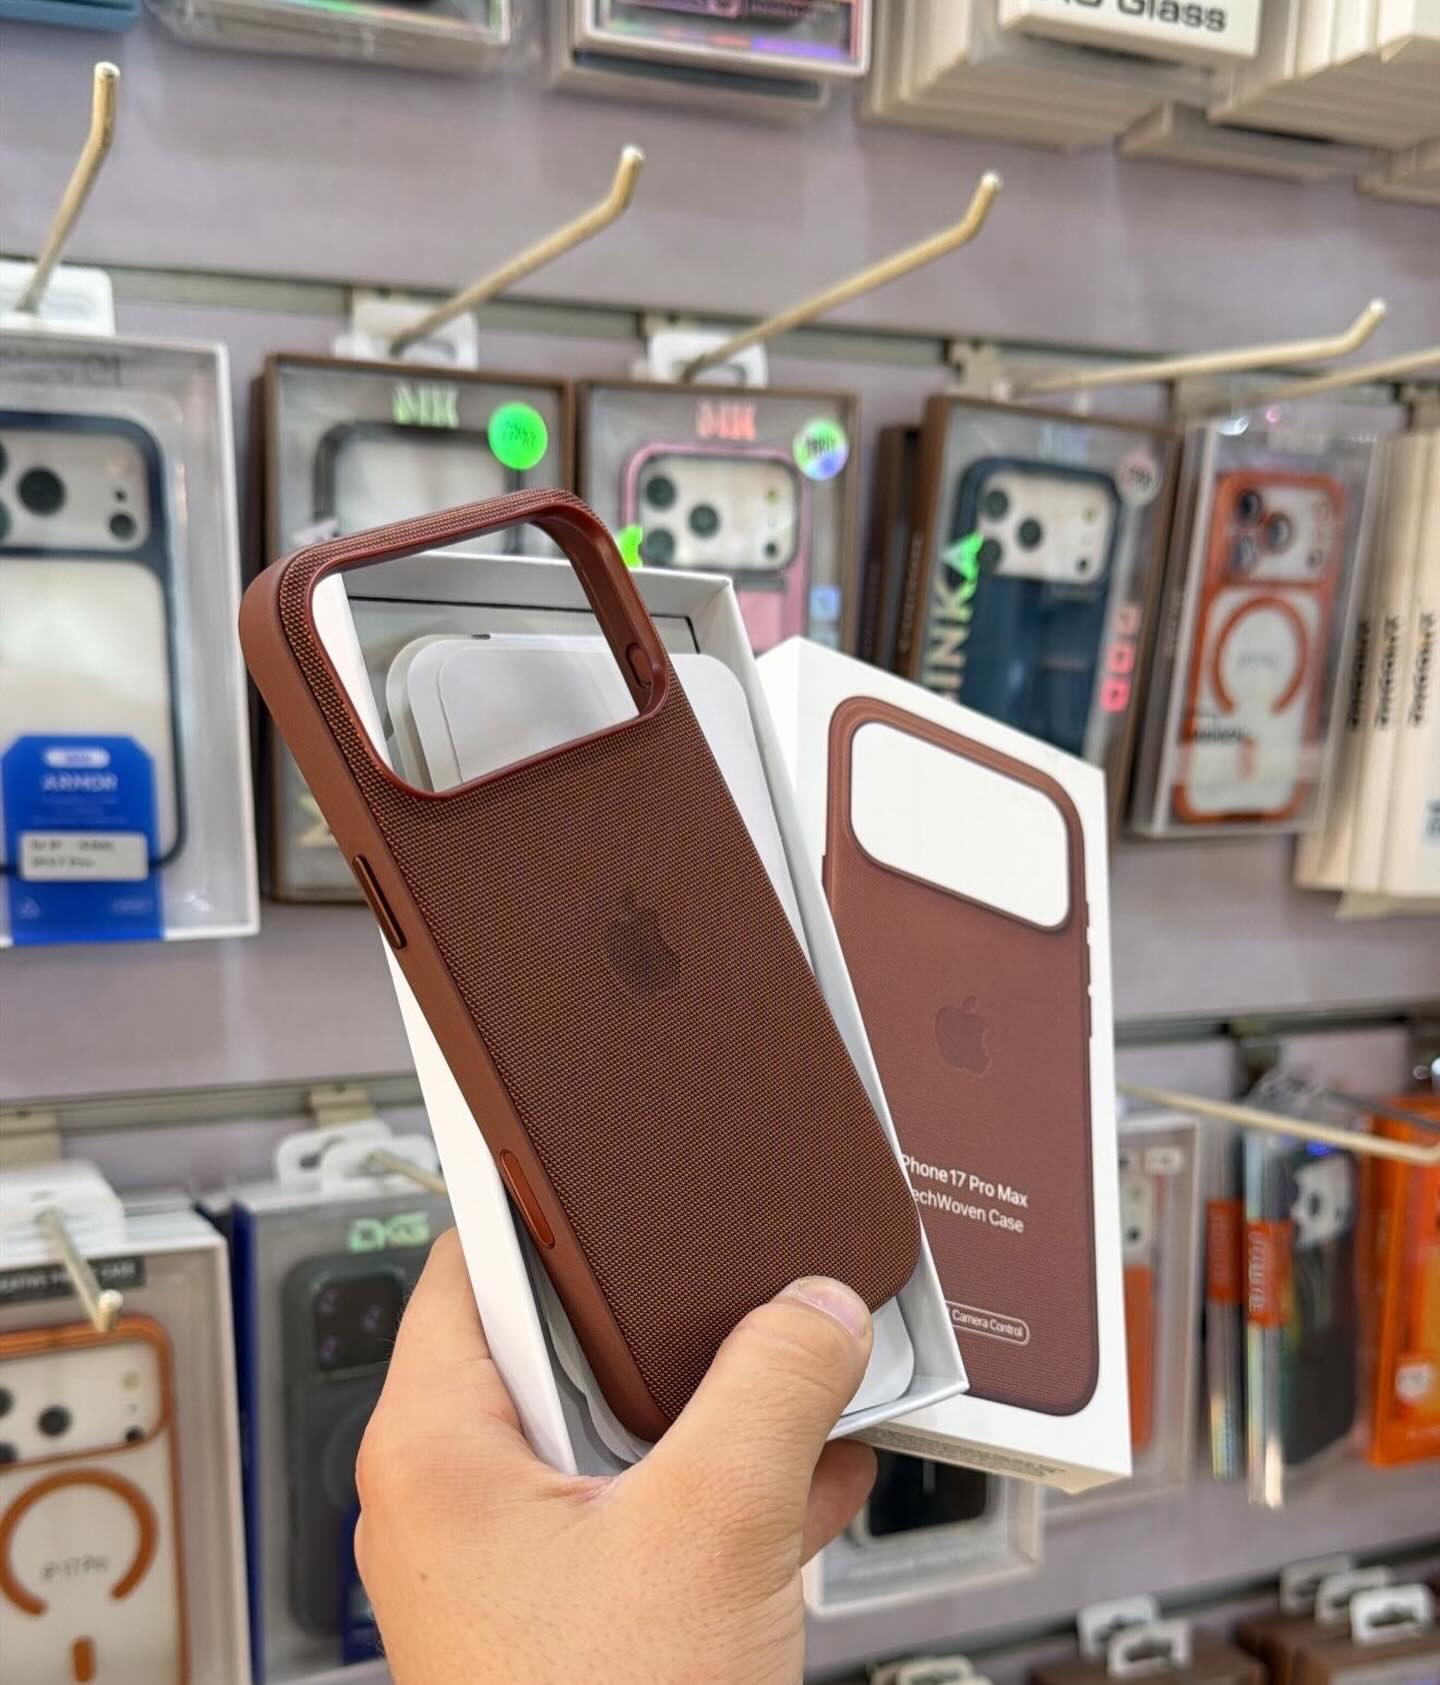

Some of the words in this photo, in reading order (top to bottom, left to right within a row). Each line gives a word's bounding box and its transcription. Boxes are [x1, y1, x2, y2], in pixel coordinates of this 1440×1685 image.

[922, 529, 984, 698] INKA
[900, 1153, 948, 1183] Phone
[949, 1169, 967, 1188] 17
[969, 1174, 995, 1197] Pro
[997, 1183, 1028, 1208] Max
[911, 1187, 987, 1222] echWoven
[988, 1208, 1025, 1233] Case
[951, 1308, 989, 1329] Camera
[989, 1318, 1023, 1338] Control
